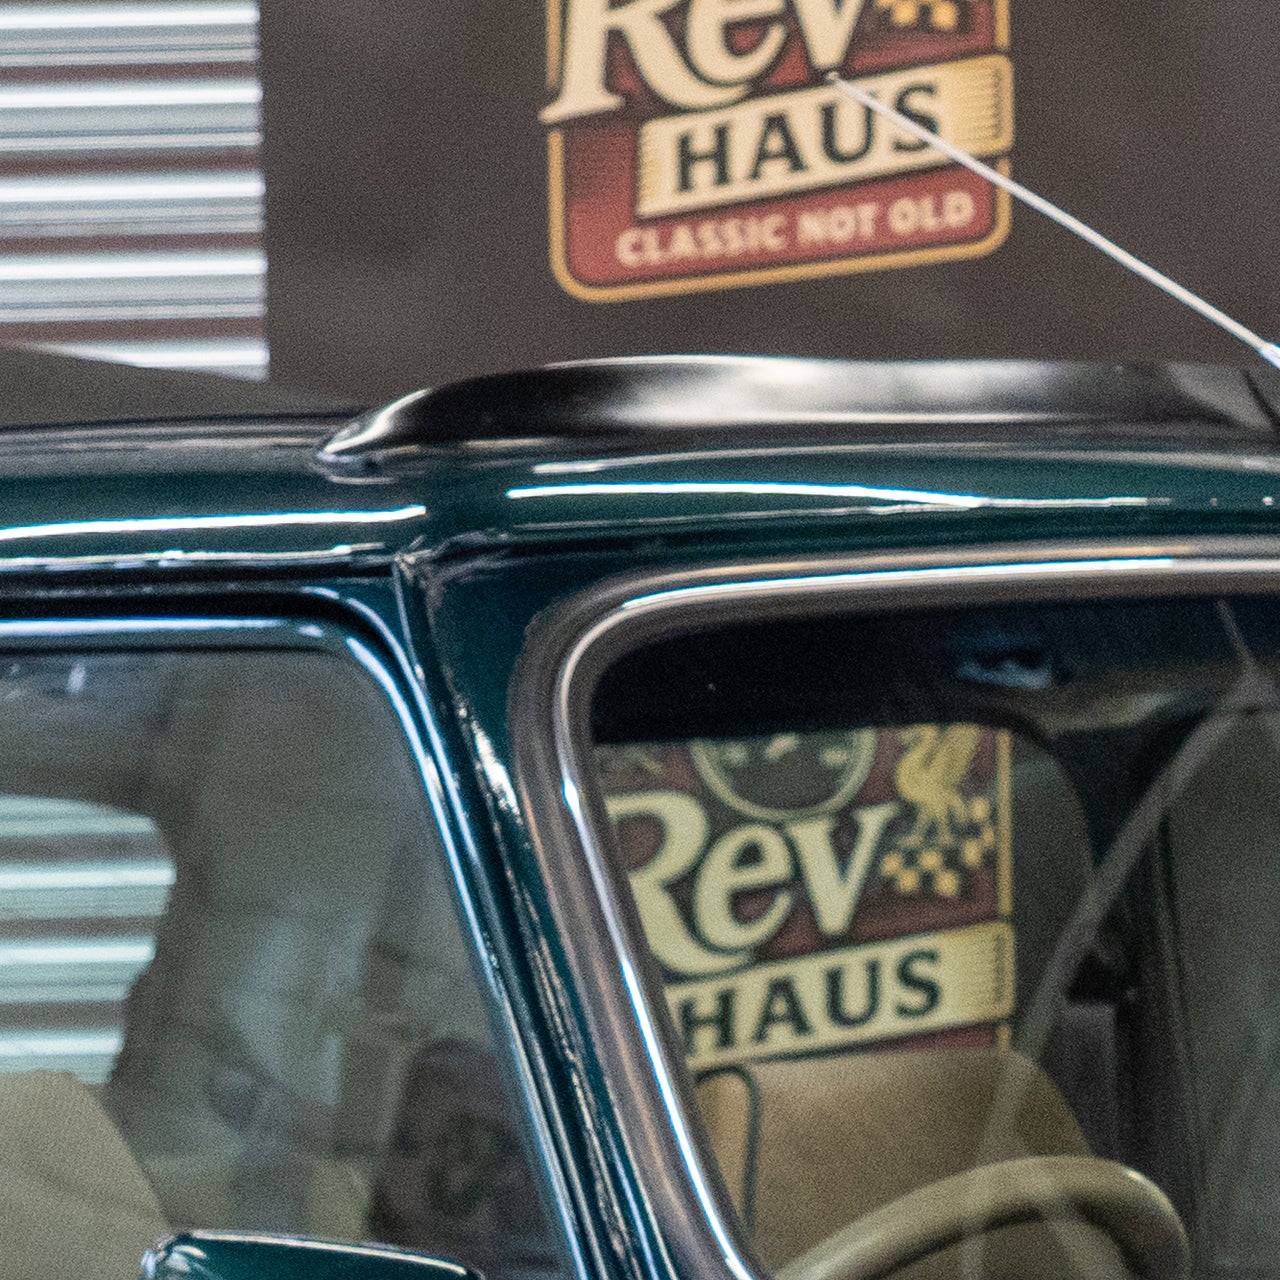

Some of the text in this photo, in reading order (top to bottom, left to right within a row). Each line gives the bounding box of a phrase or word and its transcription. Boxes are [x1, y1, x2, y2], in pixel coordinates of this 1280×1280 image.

[675, 81, 942, 193] HAUS
[614, 190, 974, 269] CLASSIC NOT OLD
[676, 947, 942, 1058] HAUS
